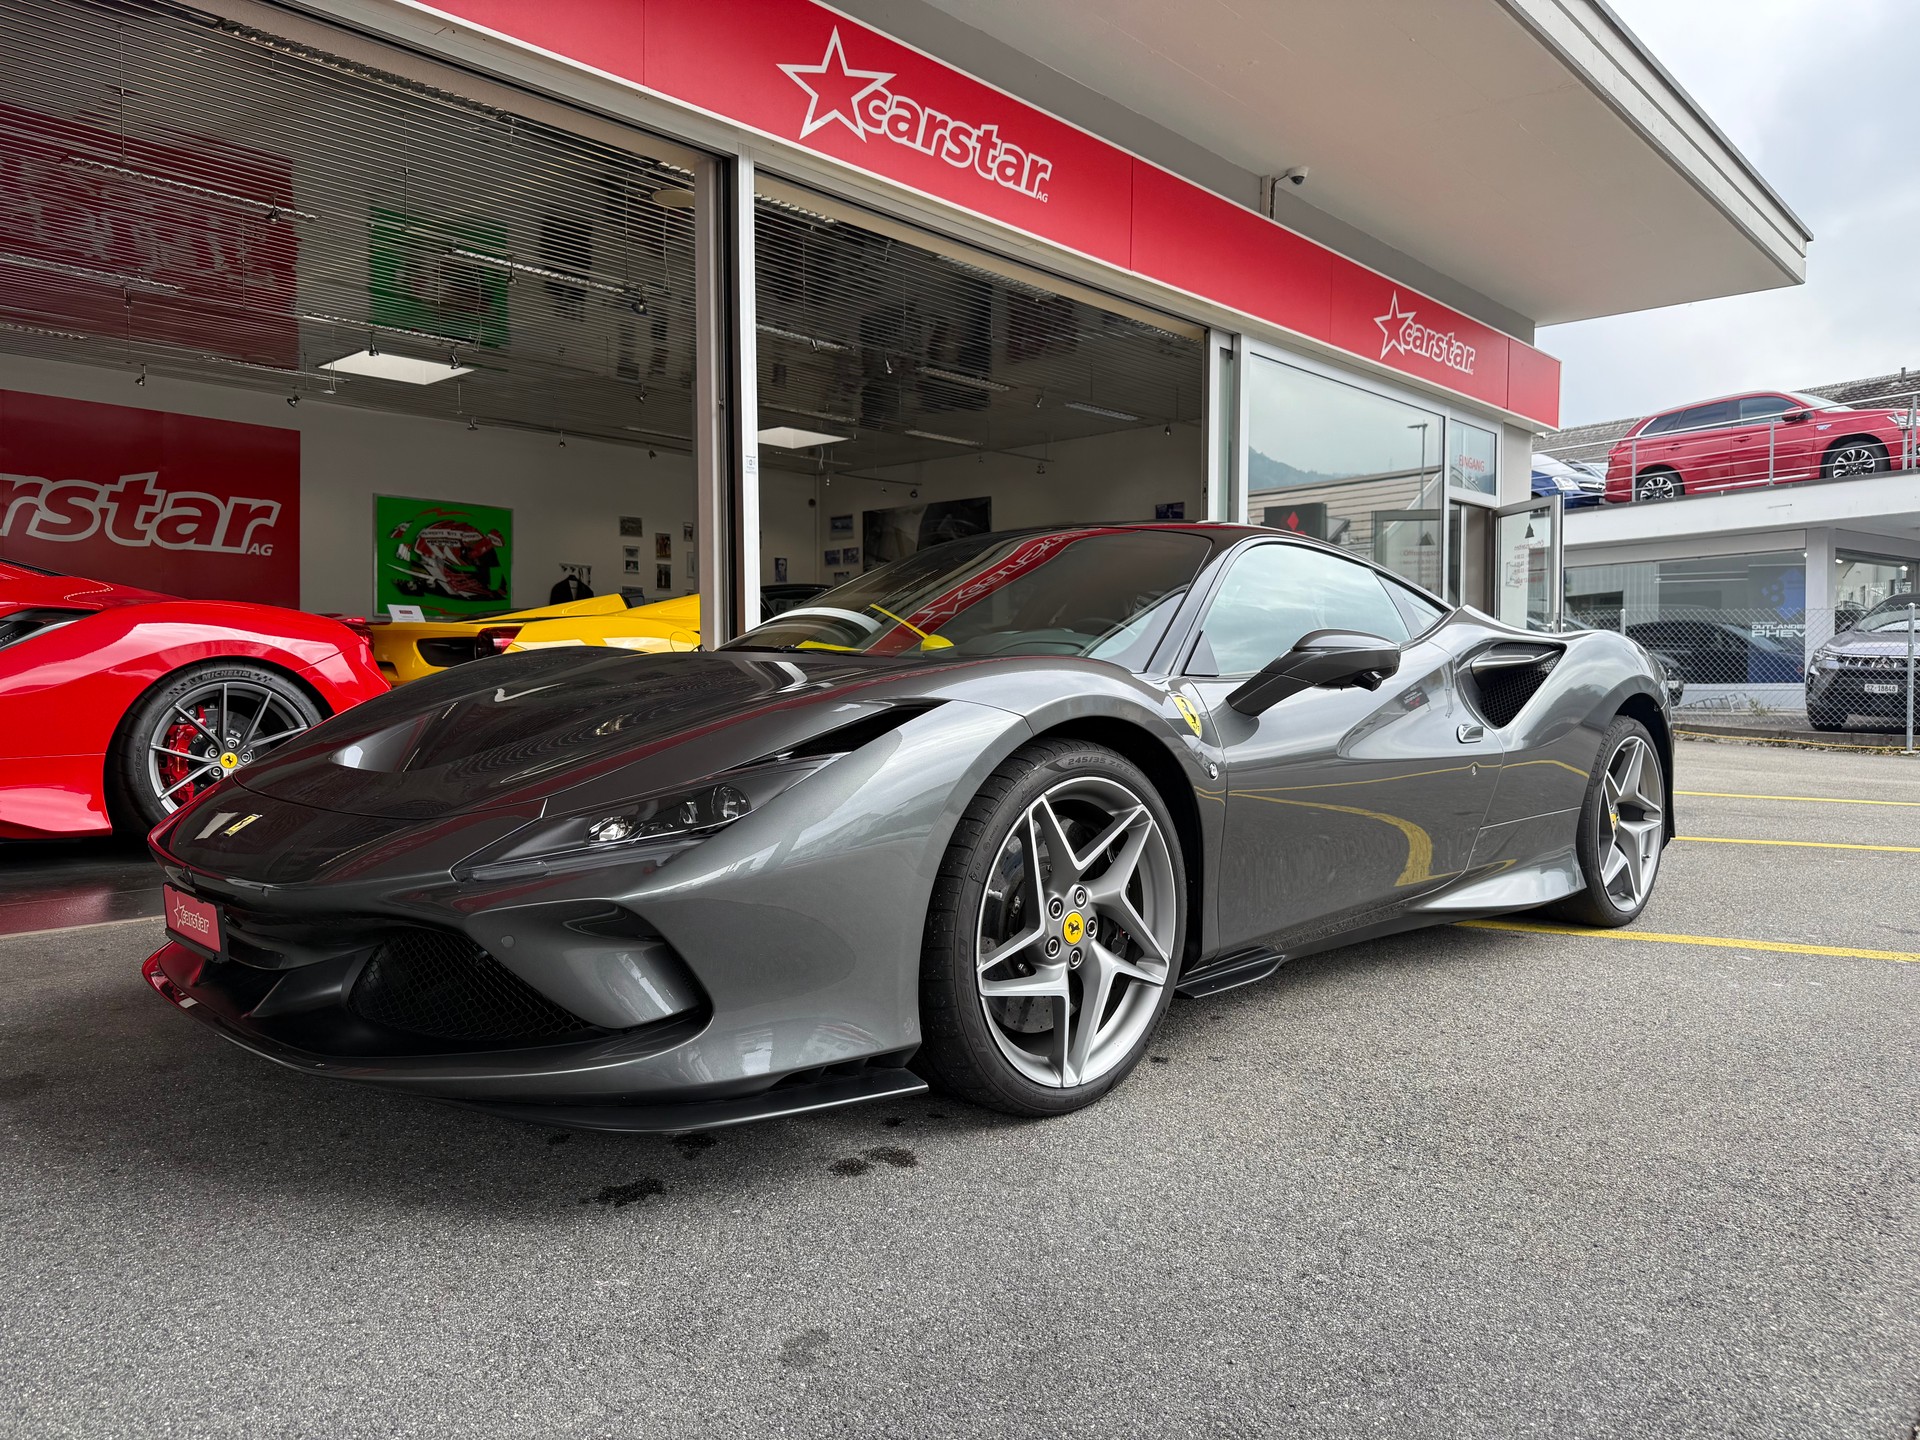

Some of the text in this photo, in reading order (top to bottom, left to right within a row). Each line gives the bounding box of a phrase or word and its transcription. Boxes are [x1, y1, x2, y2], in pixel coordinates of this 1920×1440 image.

[855, 85, 1053, 203] carstar AG
[1400, 320, 1476, 374] carstar
[1458, 454, 1485, 472] EINGANG
[247, 543, 274, 556] AG
[1751, 629, 1806, 638] PHEV
[201, 669, 251, 681] MICHELIN
[1067, 756, 1106, 766] 245/35
[181, 909, 210, 934] carstar
